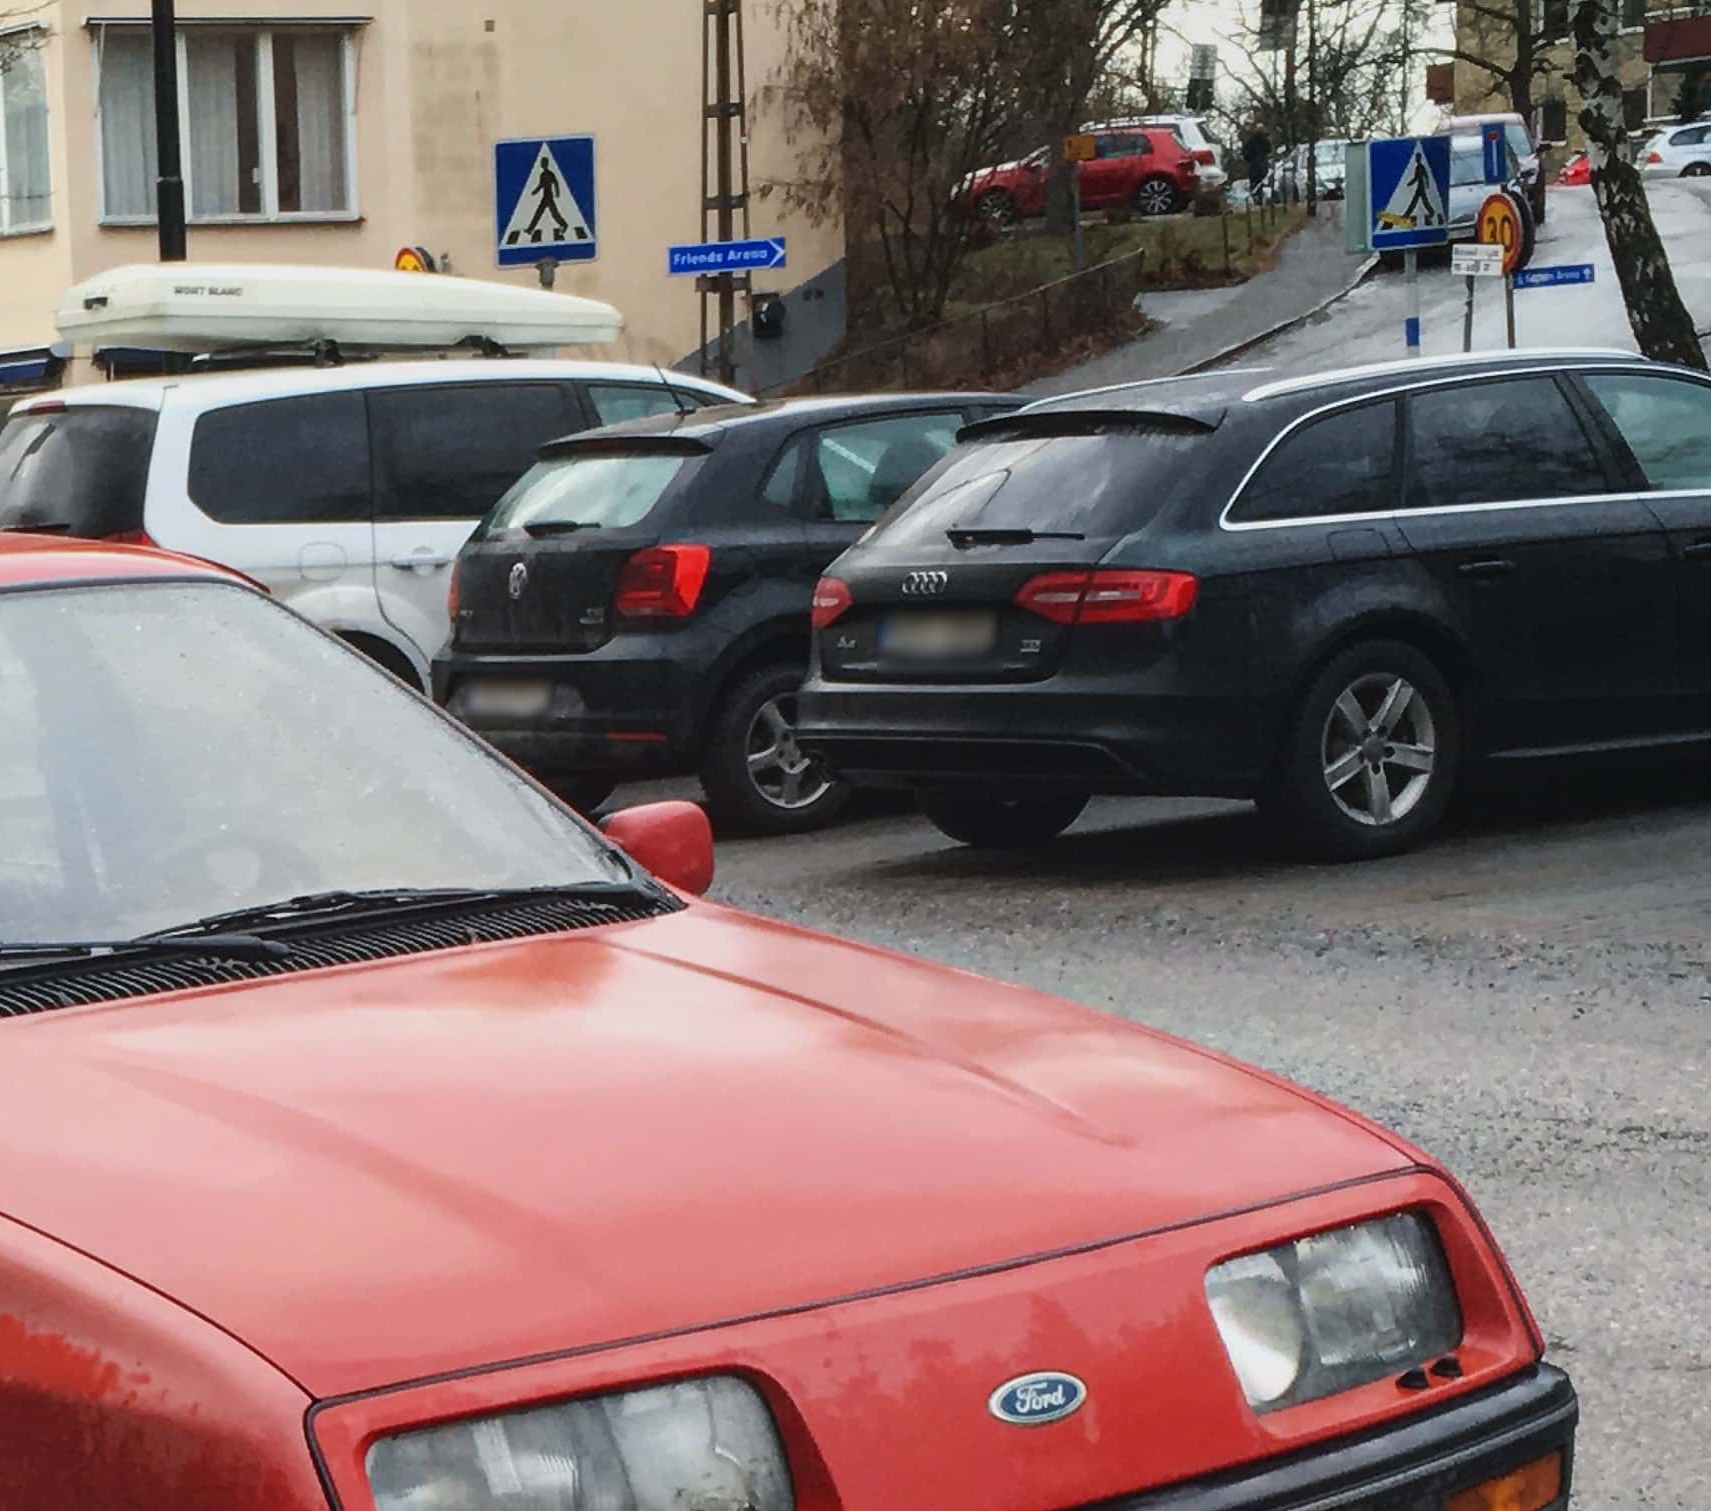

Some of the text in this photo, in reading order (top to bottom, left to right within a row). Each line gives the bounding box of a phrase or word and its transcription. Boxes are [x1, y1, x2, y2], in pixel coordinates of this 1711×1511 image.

[673, 249, 768, 265] Friends Arena
[1015, 1382, 1066, 1413] Ford
